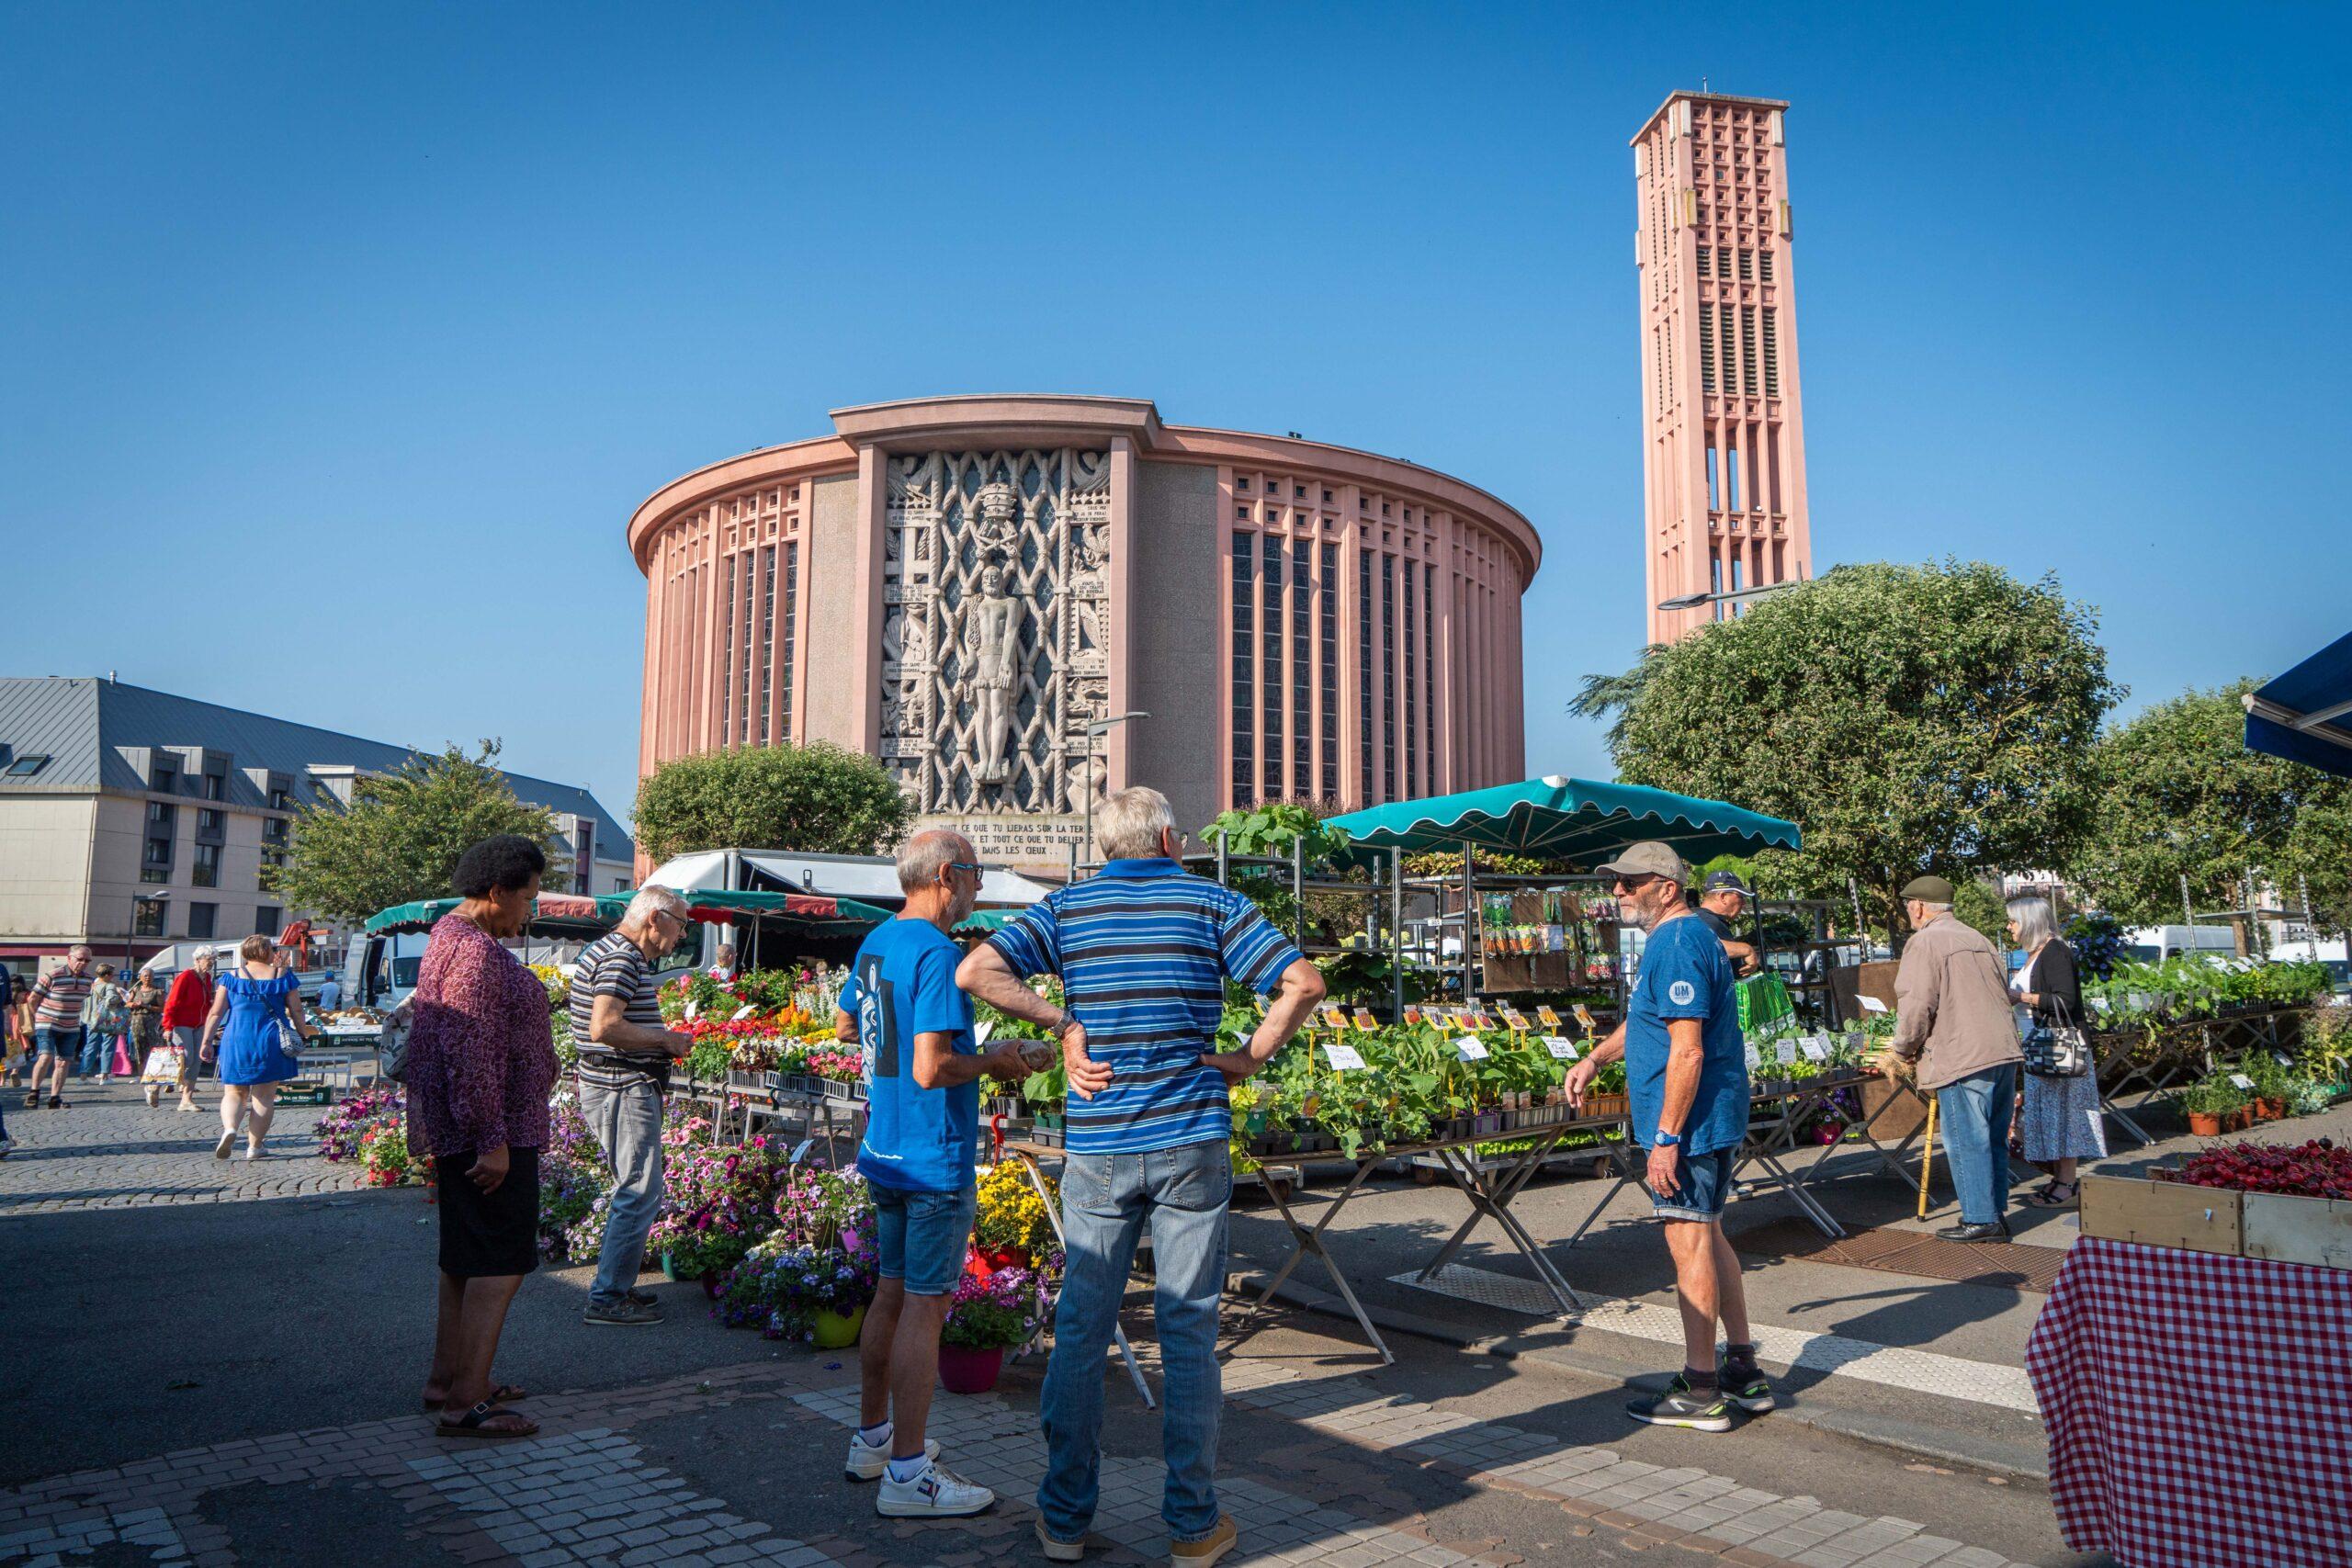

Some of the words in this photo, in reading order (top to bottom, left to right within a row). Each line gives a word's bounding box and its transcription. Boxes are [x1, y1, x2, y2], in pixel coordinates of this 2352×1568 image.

[980, 835, 989, 843] ET
[993, 835, 1011, 843] TOUT
[1014, 835, 1023, 843] CE
[1027, 835, 1042, 843] QUE
[1057, 836, 1094, 844] DELIERS
[982, 846, 1001, 854] DANS
[1674, 986, 1690, 997] UM
